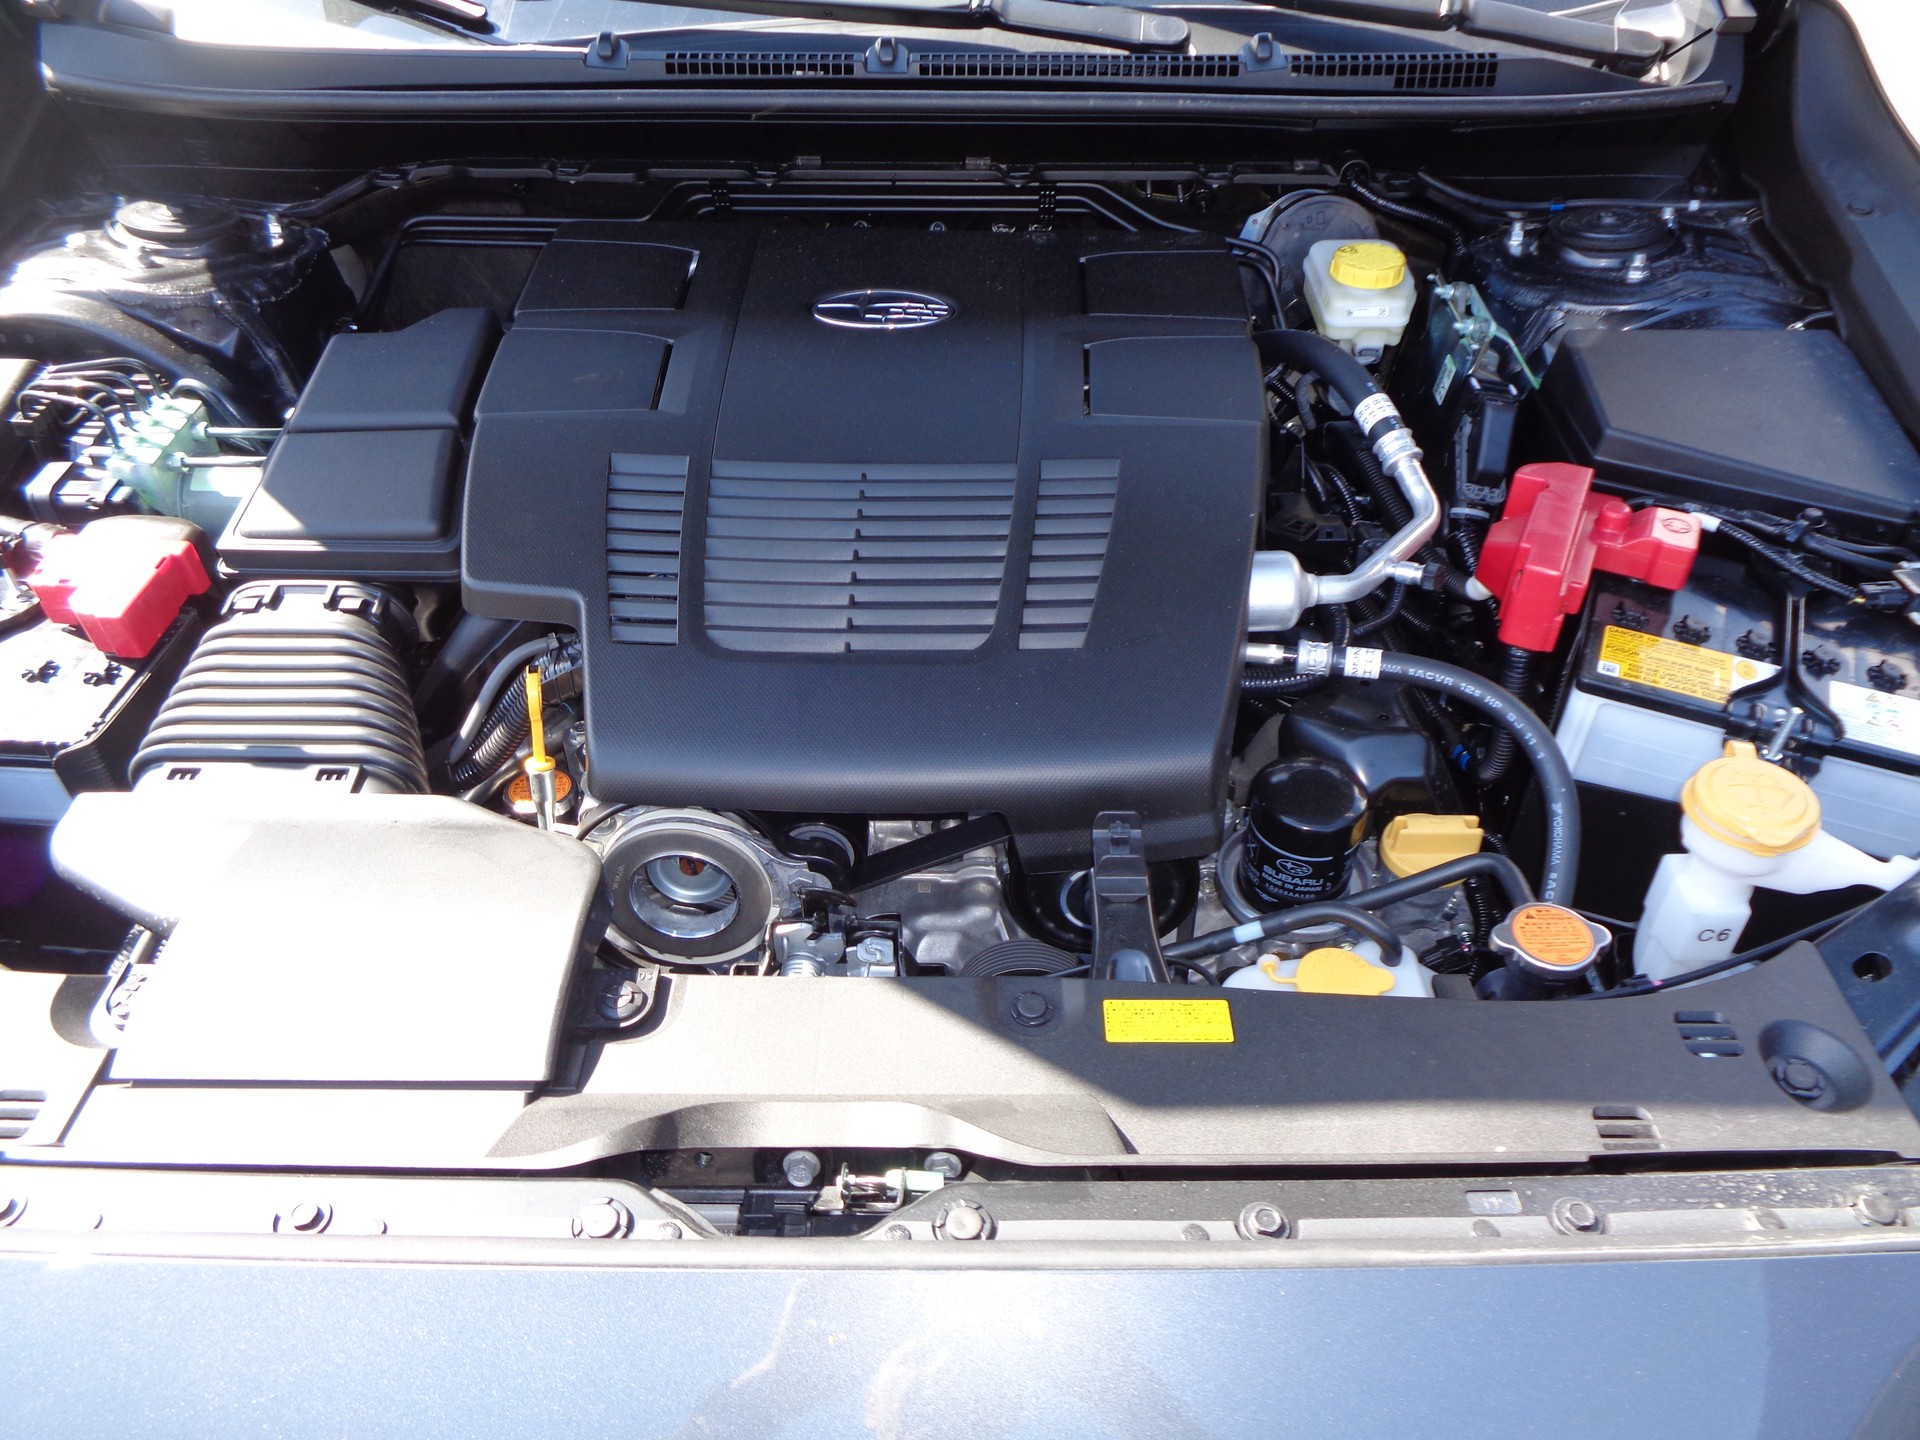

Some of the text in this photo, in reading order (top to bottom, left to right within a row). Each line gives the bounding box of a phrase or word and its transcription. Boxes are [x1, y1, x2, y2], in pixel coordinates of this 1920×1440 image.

[1550, 814, 1564, 866] YOKOHAMA
[1262, 872, 1283, 886] MADE
[1263, 864, 1324, 886] SUBARU
[1698, 928, 1733, 942] C6
